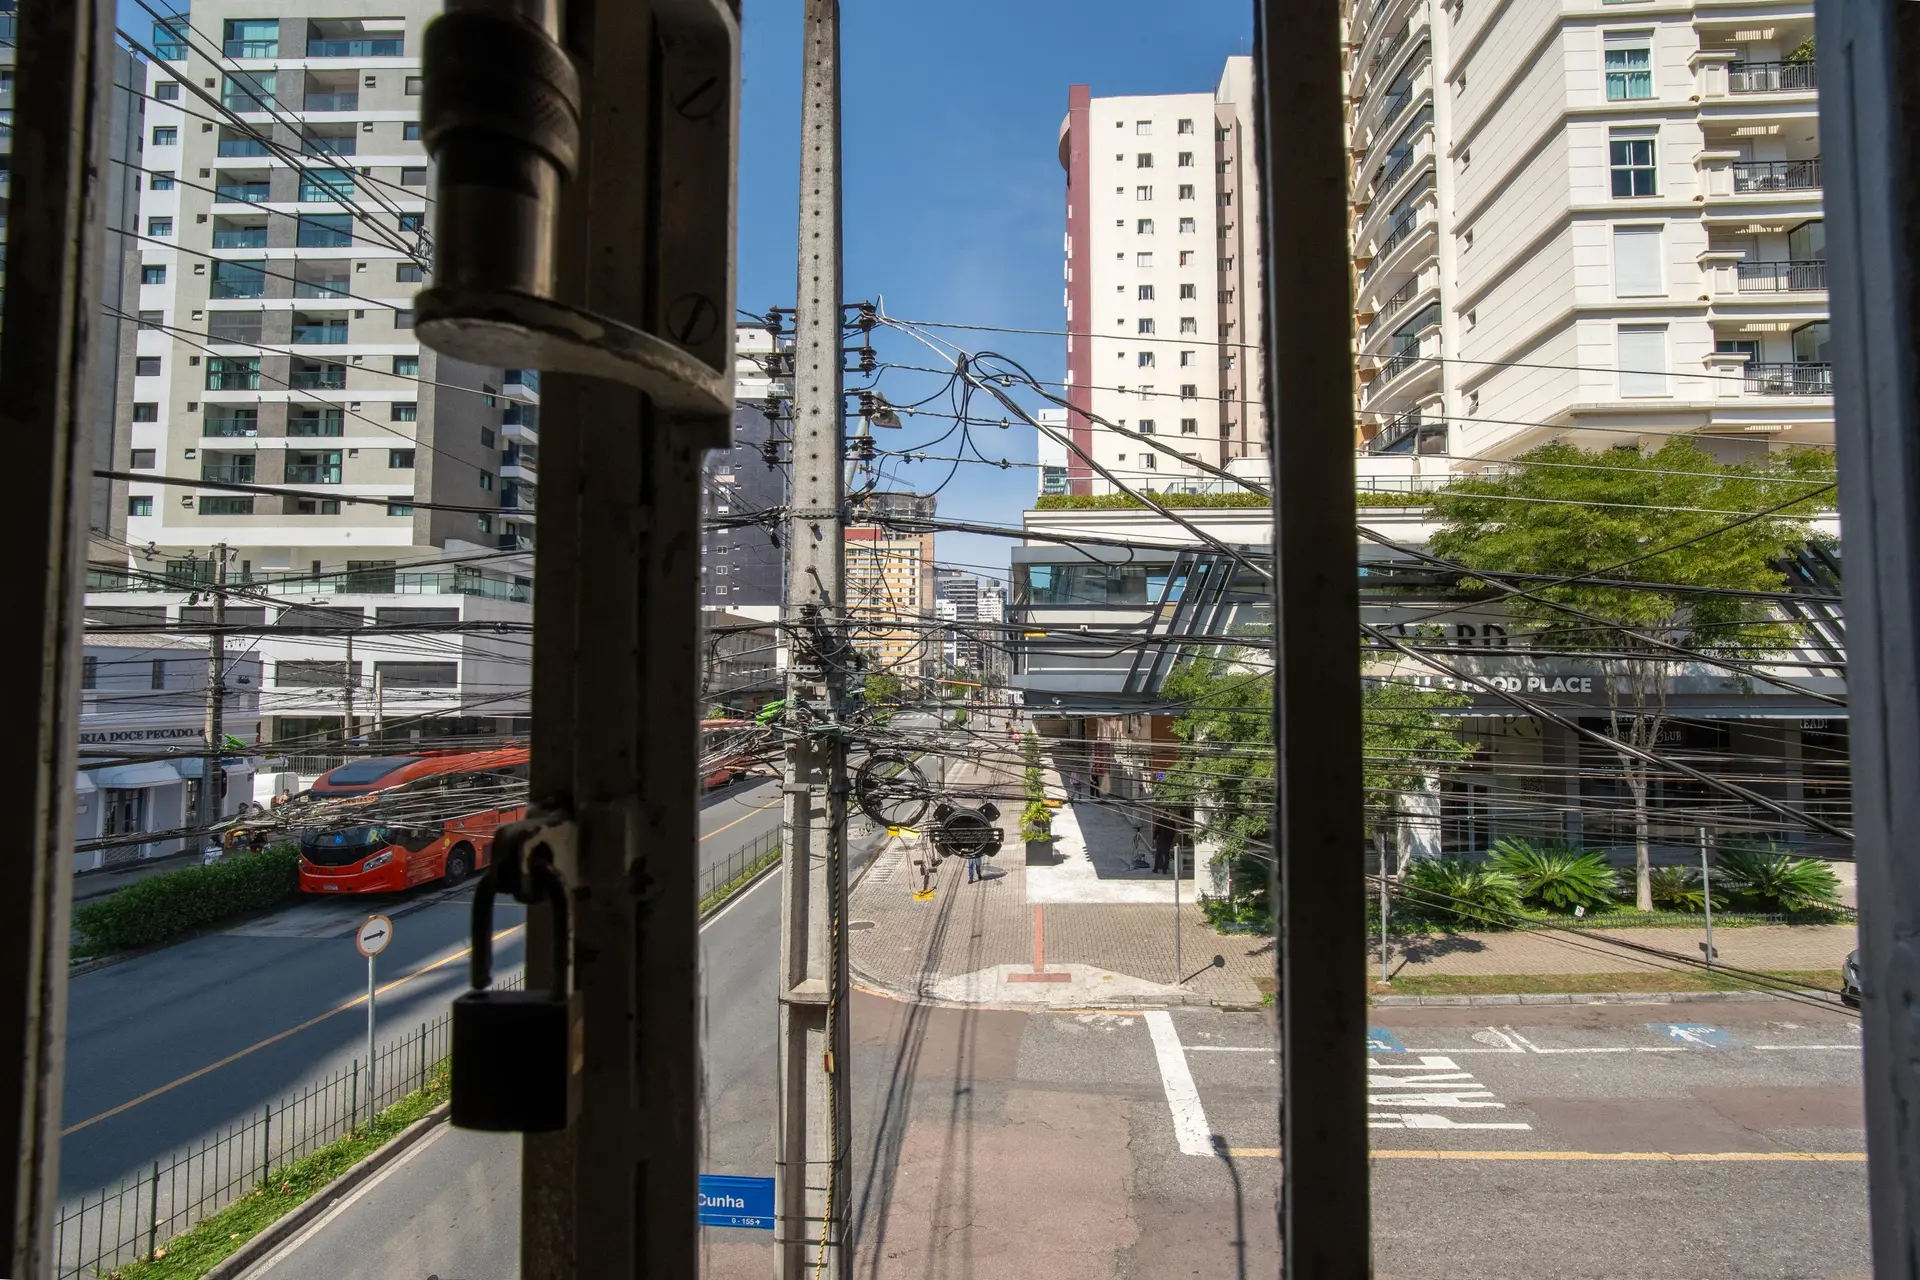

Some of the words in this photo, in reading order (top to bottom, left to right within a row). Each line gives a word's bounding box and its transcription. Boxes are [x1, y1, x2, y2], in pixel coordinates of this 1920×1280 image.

[1527, 677, 1592, 693] PLACE
[109, 731, 144, 742] DOCE
[145, 728, 194, 740] PECADO
[697, 1193, 745, 1208] Cunha
